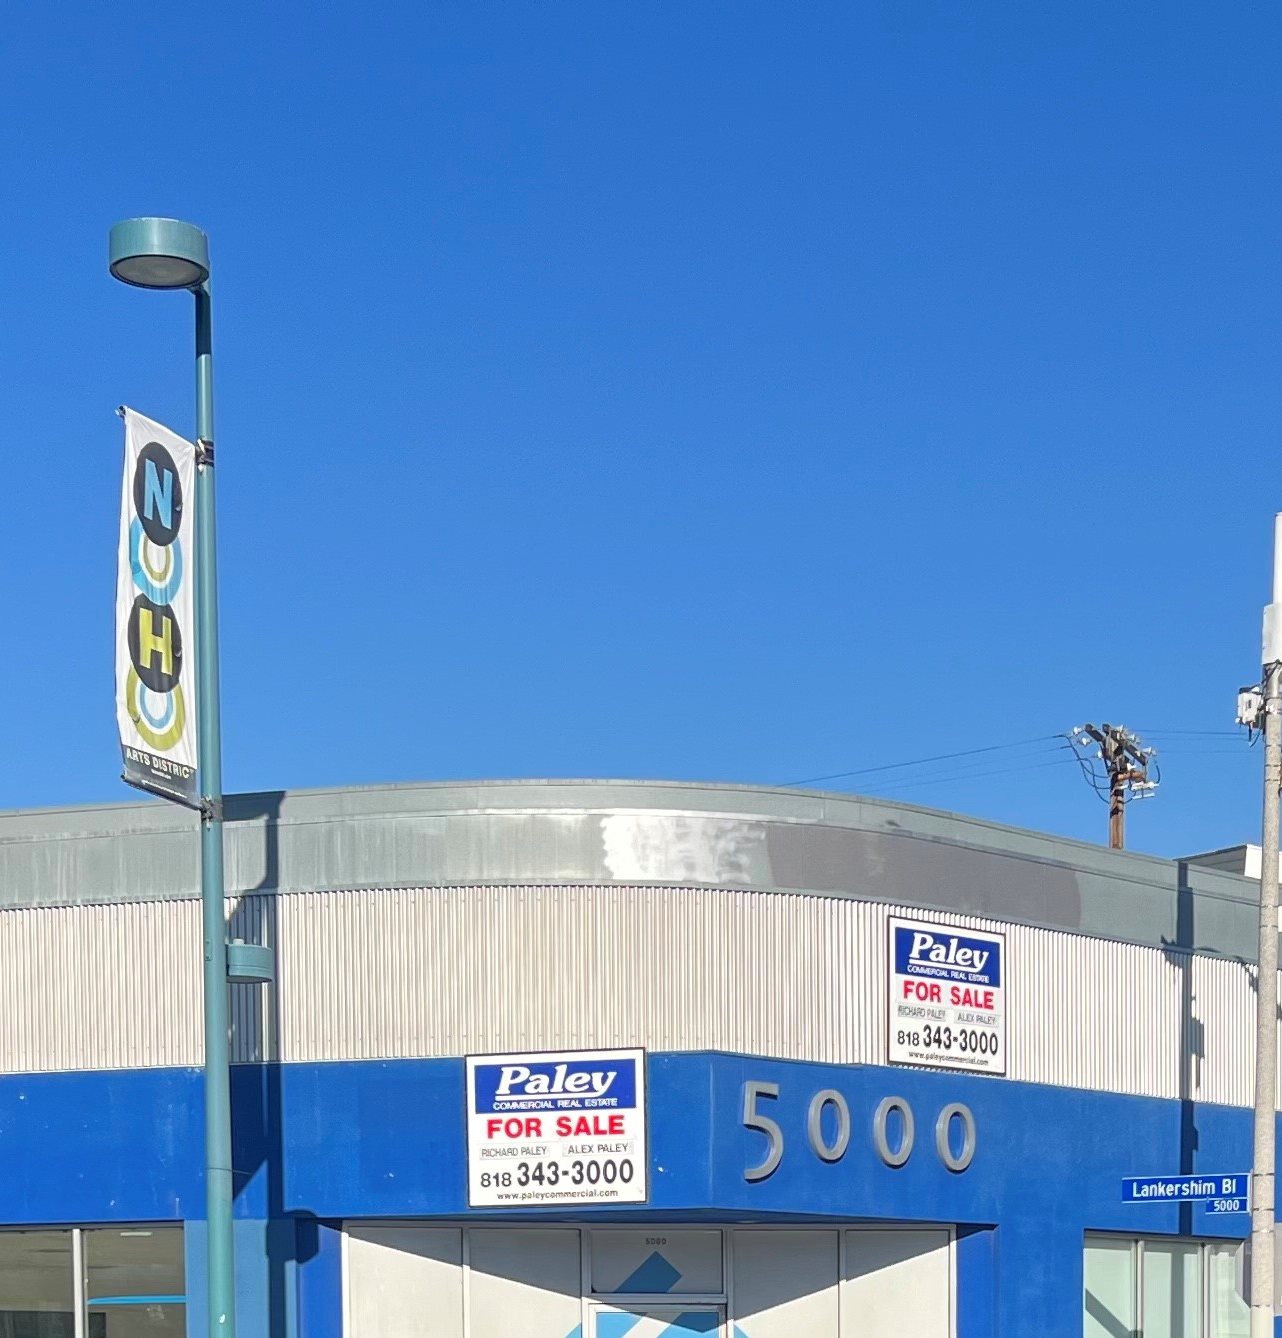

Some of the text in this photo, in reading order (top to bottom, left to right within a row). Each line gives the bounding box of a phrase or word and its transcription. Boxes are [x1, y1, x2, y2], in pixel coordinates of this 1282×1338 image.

[126, 748, 151, 766] ARTS
[152, 756, 195, 779] DISTRIC
[909, 932, 989, 973] Paley
[907, 965, 949, 978] COMMERCIAL
[951, 970, 967, 980] REAL
[903, 980, 994, 1010] FOR SALE
[898, 1005, 946, 1019] RICHARD PALEY
[957, 1013, 996, 1025] ALEX PALEY
[897, 1024, 998, 1056] 818 343-3000
[909, 1051, 989, 1066] www.paleycommercial.com
[495, 1064, 617, 1101] Paley
[493, 1098, 617, 1111] COMMERCIAL REAL ESTATE
[487, 1115, 625, 1139] FOR SALE
[743, 1080, 976, 1184] 5000
[481, 1146, 547, 1157] RICHARD PALEY
[568, 1143, 628, 1154] ALEX PALEY
[480, 1159, 634, 1187] 818 343-3000
[497, 1189, 619, 1201] www.paleycommercial.com
[1132, 1178, 1236, 1198] Lankershim Bl
[1213, 1200, 1239, 1211] 5000
